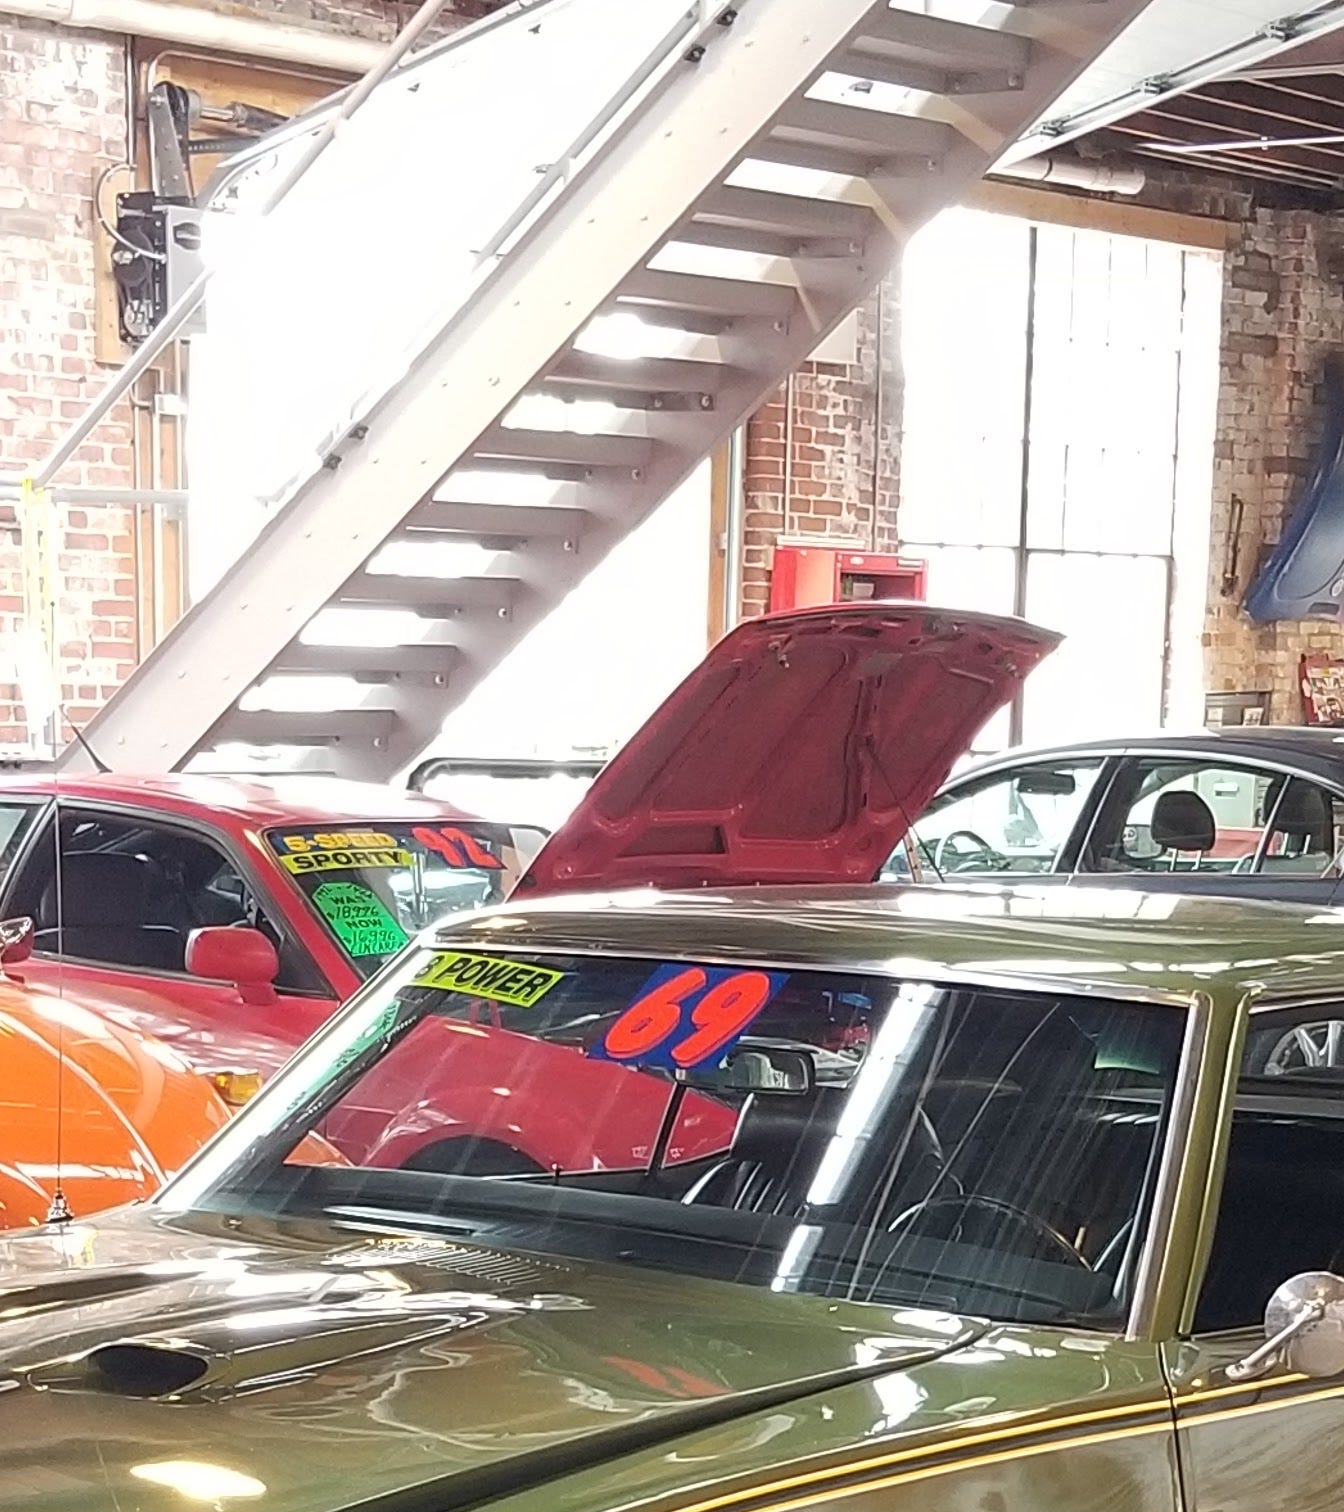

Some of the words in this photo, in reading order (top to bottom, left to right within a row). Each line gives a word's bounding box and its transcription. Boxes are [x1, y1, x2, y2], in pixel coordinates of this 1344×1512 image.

[283, 832, 398, 852] 5-SPEED
[411, 826, 503, 869] 92
[292, 850, 401, 869] SPORTY
[345, 919, 383, 929] NOW
[432, 956, 555, 1002] POWER
[603, 966, 771, 1068] 69
